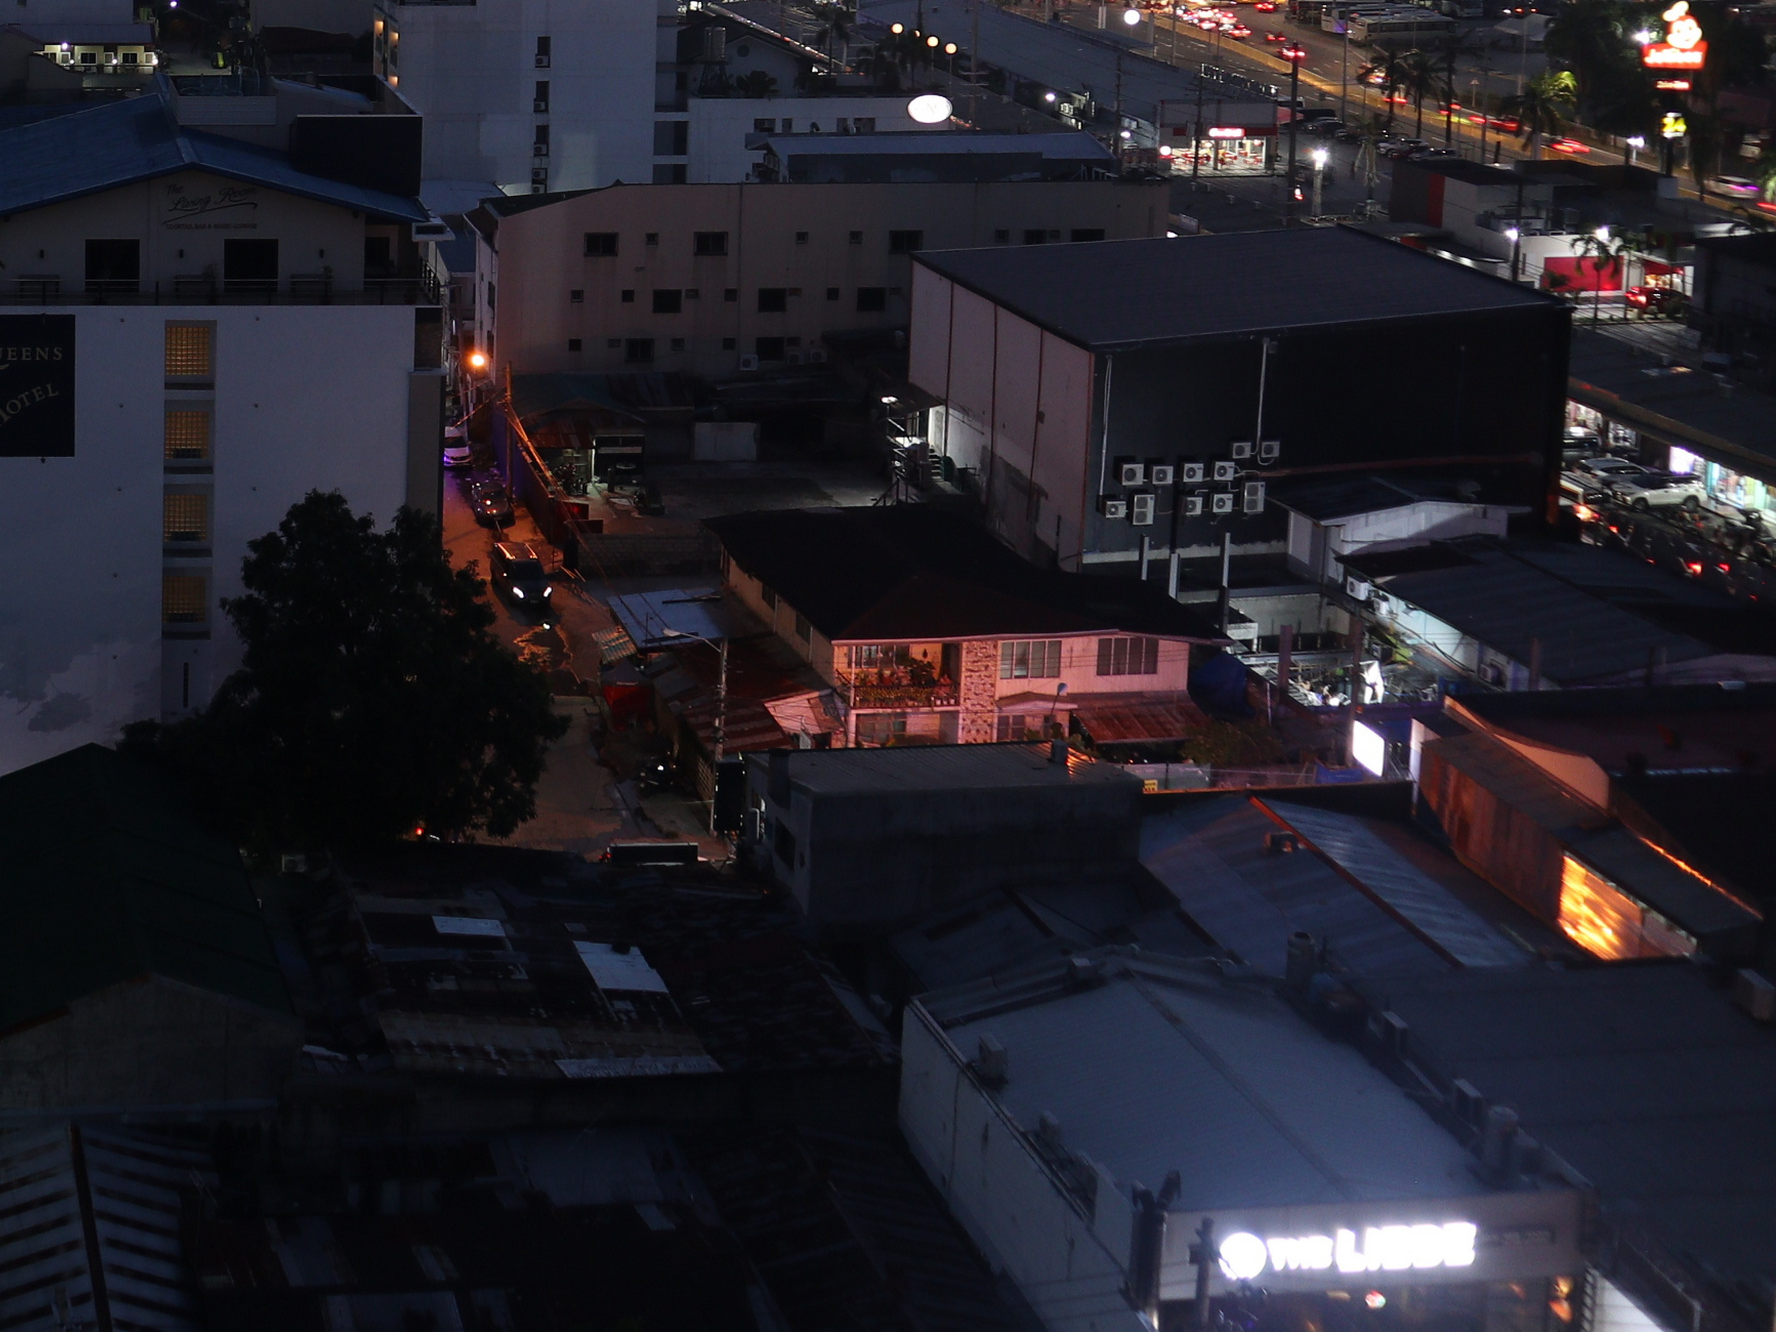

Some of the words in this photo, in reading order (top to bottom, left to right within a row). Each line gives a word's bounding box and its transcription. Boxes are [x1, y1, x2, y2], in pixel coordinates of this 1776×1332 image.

[1663, 117, 1687, 132] 24
[166, 184, 183, 197] The
[168, 195, 212, 212] Living
[1267, 1235, 1334, 1271] THE
